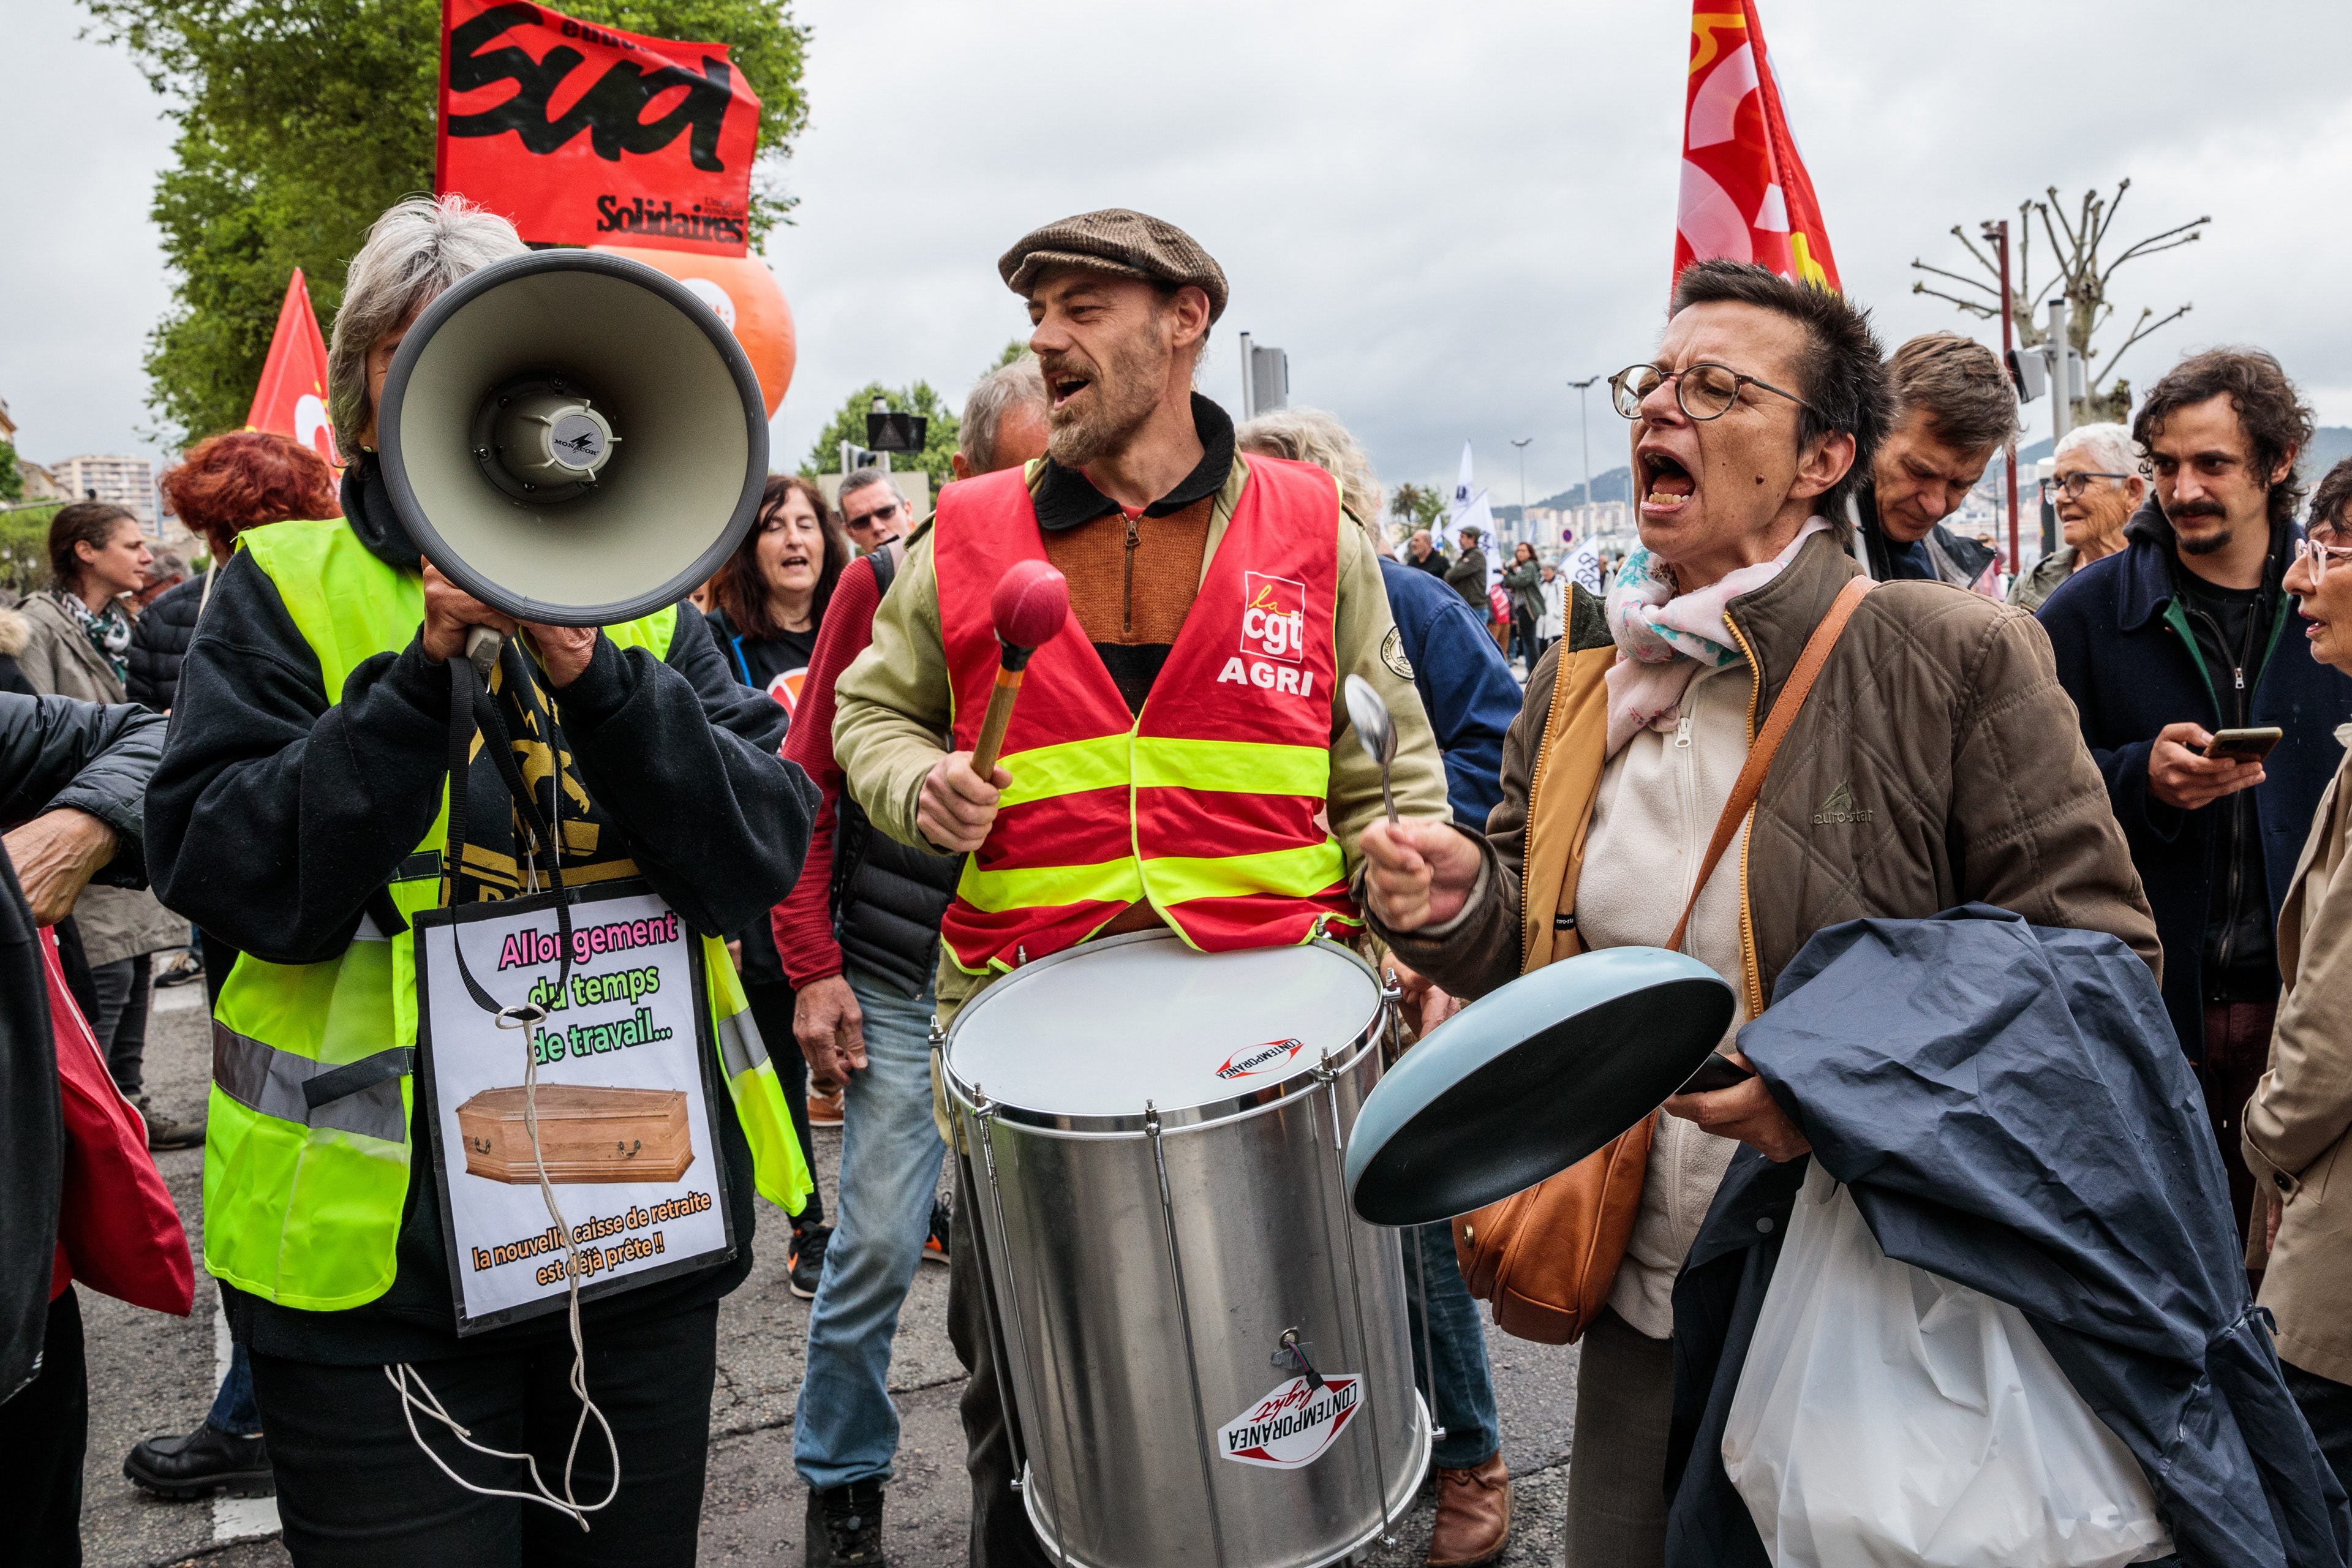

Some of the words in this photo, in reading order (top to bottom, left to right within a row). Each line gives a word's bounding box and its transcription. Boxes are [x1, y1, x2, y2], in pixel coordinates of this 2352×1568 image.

[597, 194, 744, 243] Solidaires
[554, 439, 597, 456] MONACOR
[1248, 584, 1302, 616] la
[1244, 608, 1303, 655] cgt
[1216, 657, 1314, 697] AGRI
[1813, 809, 1873, 825] euro-star
[528, 975, 570, 1012] du
[571, 965, 660, 1008] temps
[527, 1027, 566, 1066] de
[567, 1006, 673, 1058] travail...
[472, 1246, 492, 1272] la
[572, 1215, 624, 1244] caisse
[625, 1205, 650, 1230] de
[650, 1191, 712, 1224] retraite
[536, 1259, 565, 1286] est
[605, 1237, 653, 1272] prête
[1228, 1382, 1357, 1451] CONTEMPORÂNEA
[1249, 1379, 1314, 1423] light
